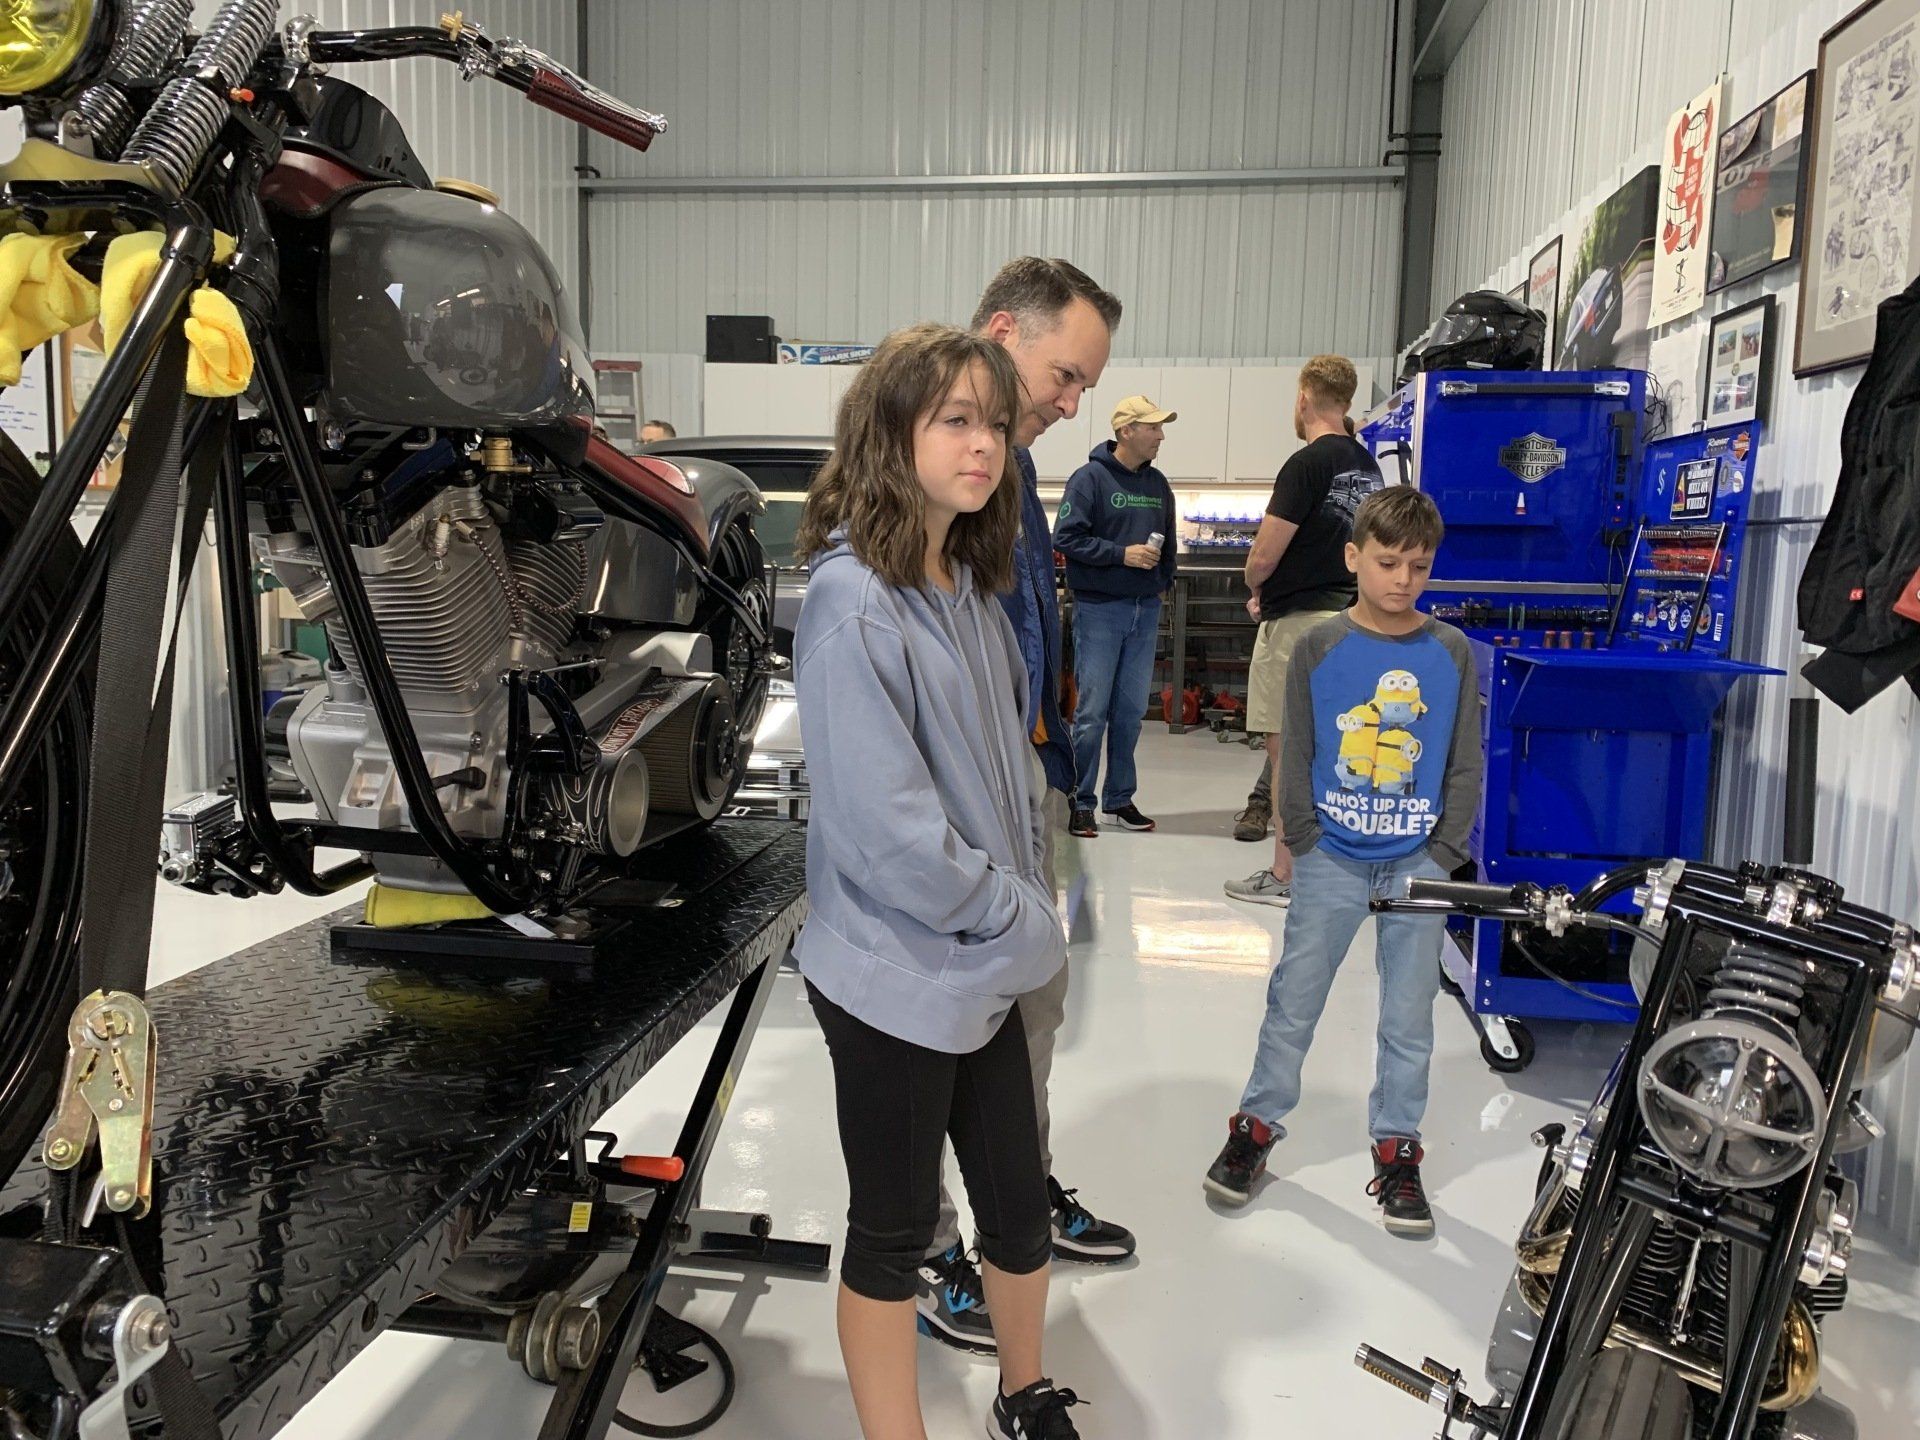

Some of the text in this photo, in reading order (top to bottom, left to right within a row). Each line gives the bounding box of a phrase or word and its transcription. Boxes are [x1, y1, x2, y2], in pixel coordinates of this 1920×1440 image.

[1518, 440, 1549, 450] MOTOR
[1504, 452, 1560, 463] HARLEY-DAVIDSON
[1516, 464, 1546, 477] CYCLES
[1325, 790, 1431, 813] WHO'S UP FOR
